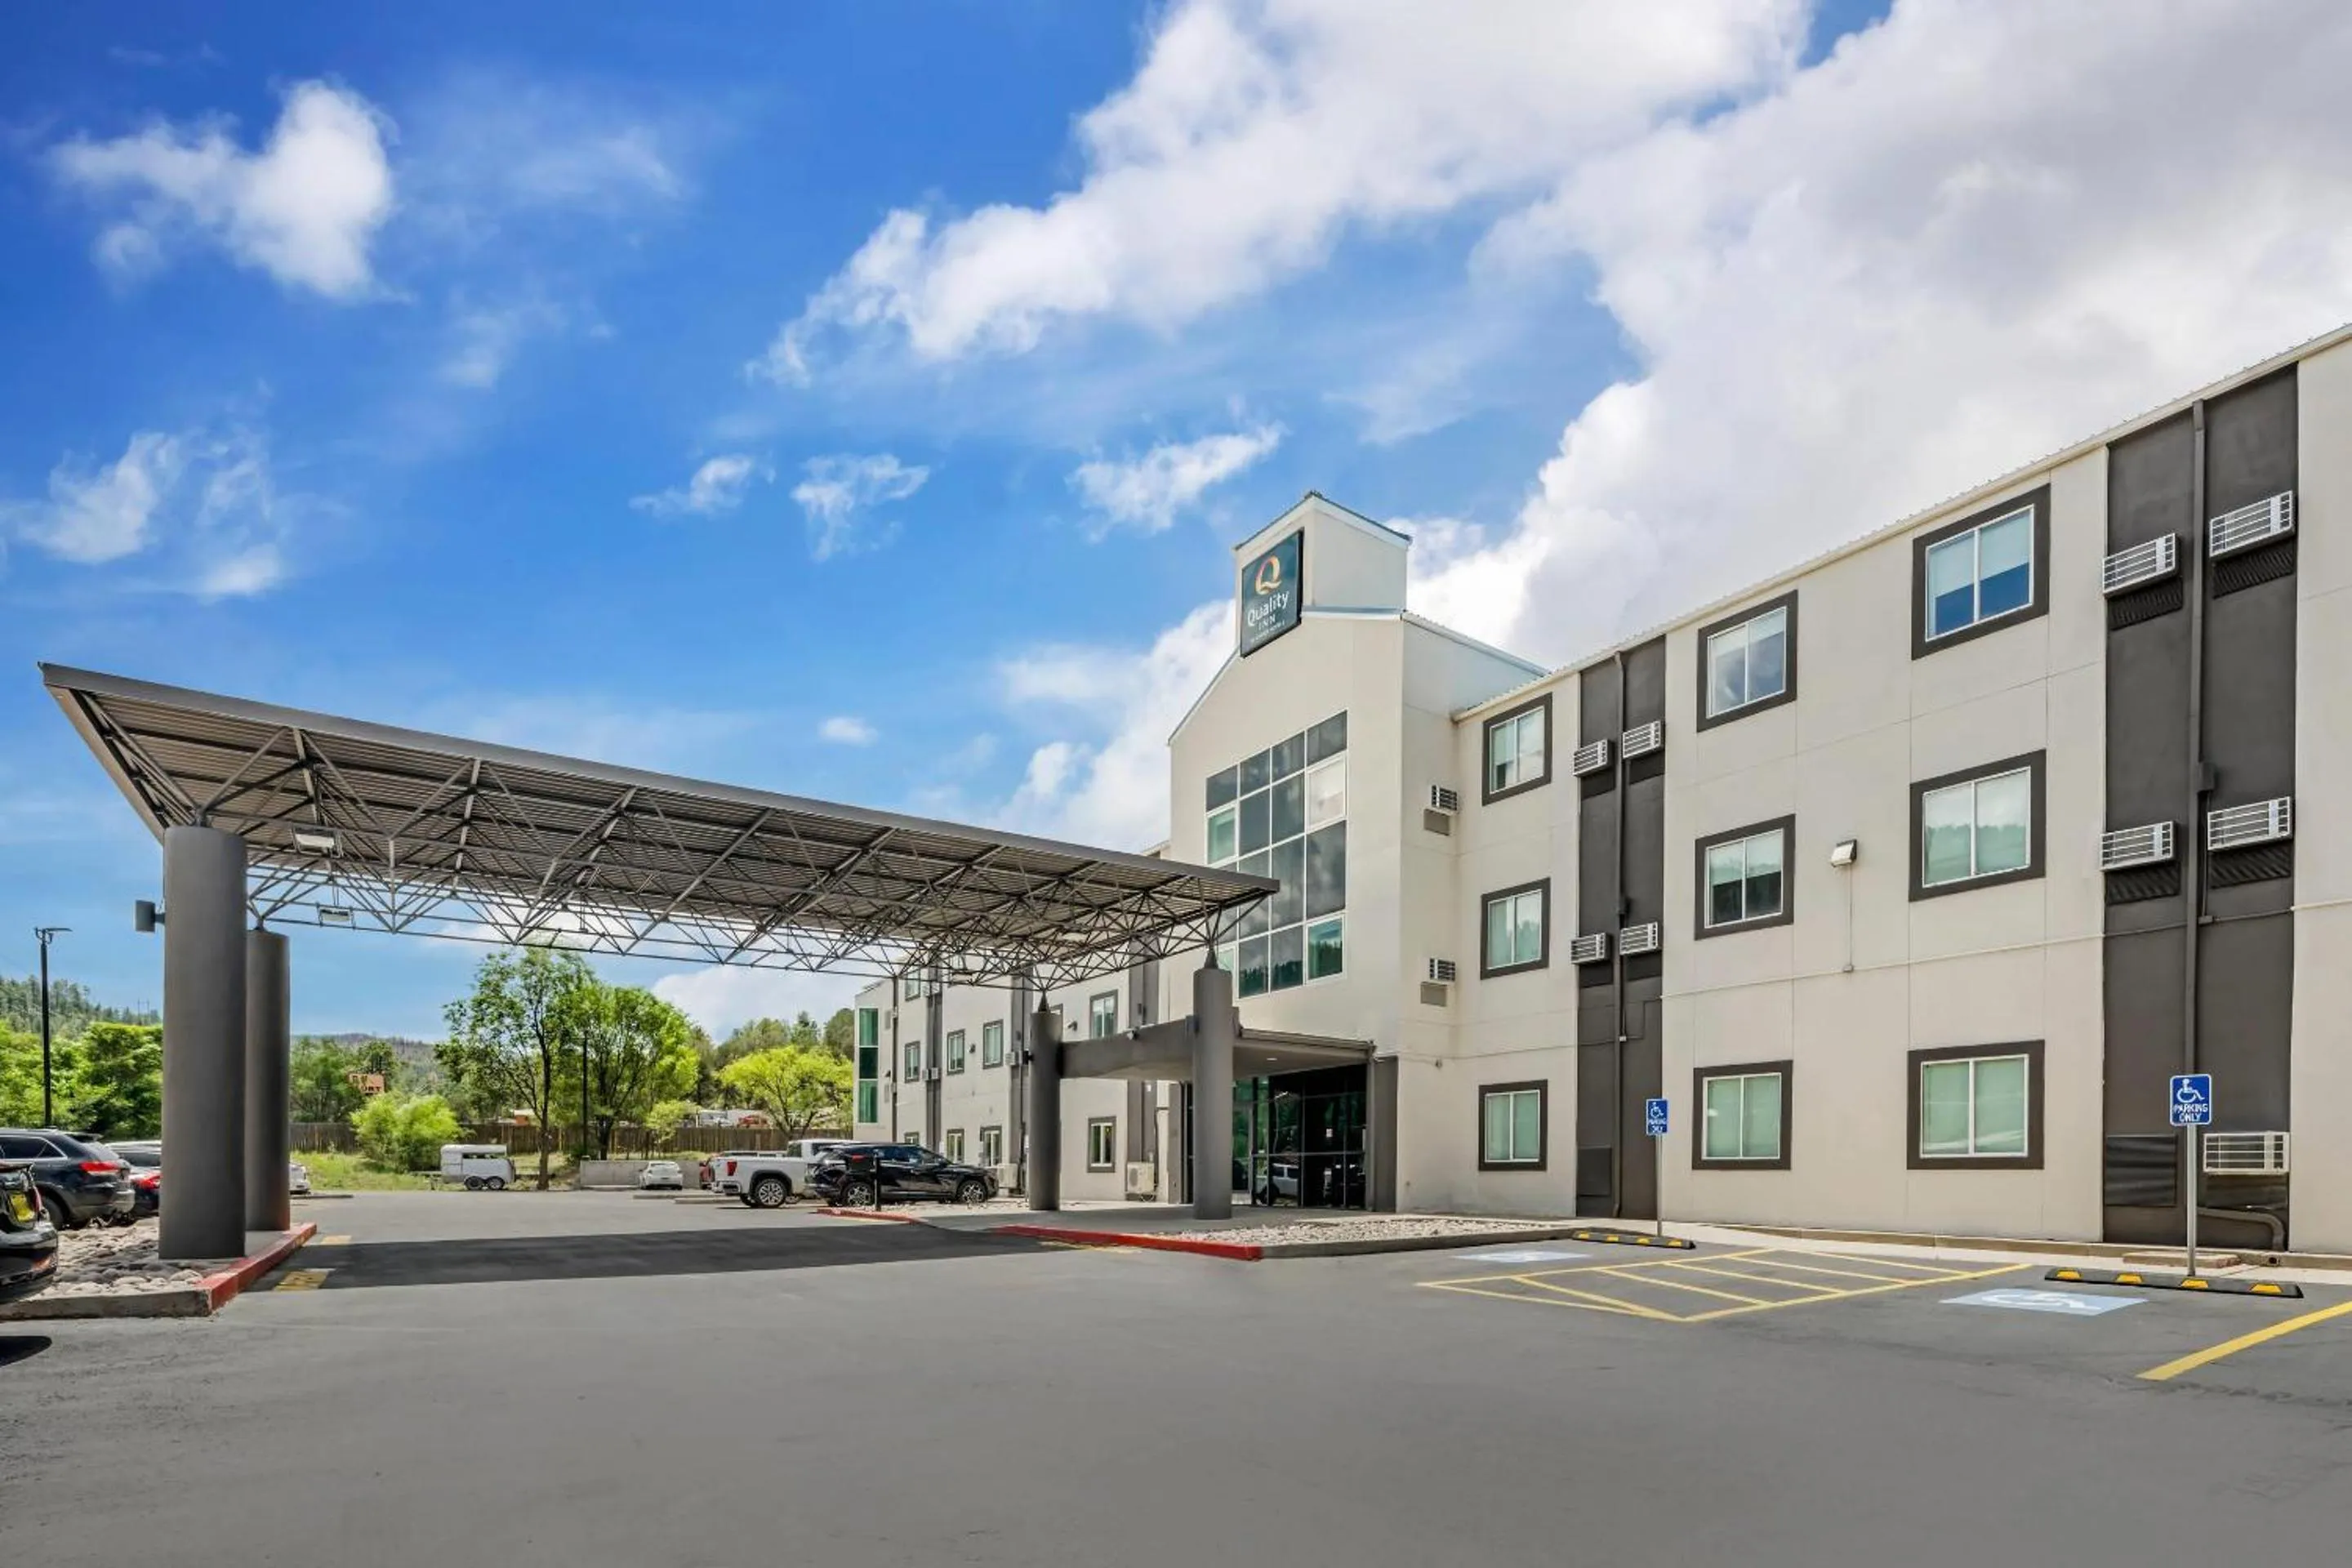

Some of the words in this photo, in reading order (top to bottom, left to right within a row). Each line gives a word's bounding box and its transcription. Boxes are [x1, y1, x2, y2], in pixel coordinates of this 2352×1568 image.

[1255, 555, 1282, 595] Q
[1247, 593, 1288, 627] Quality
[2173, 1103, 2208, 1113] PARKING
[2179, 1112, 2203, 1122] ONLY
